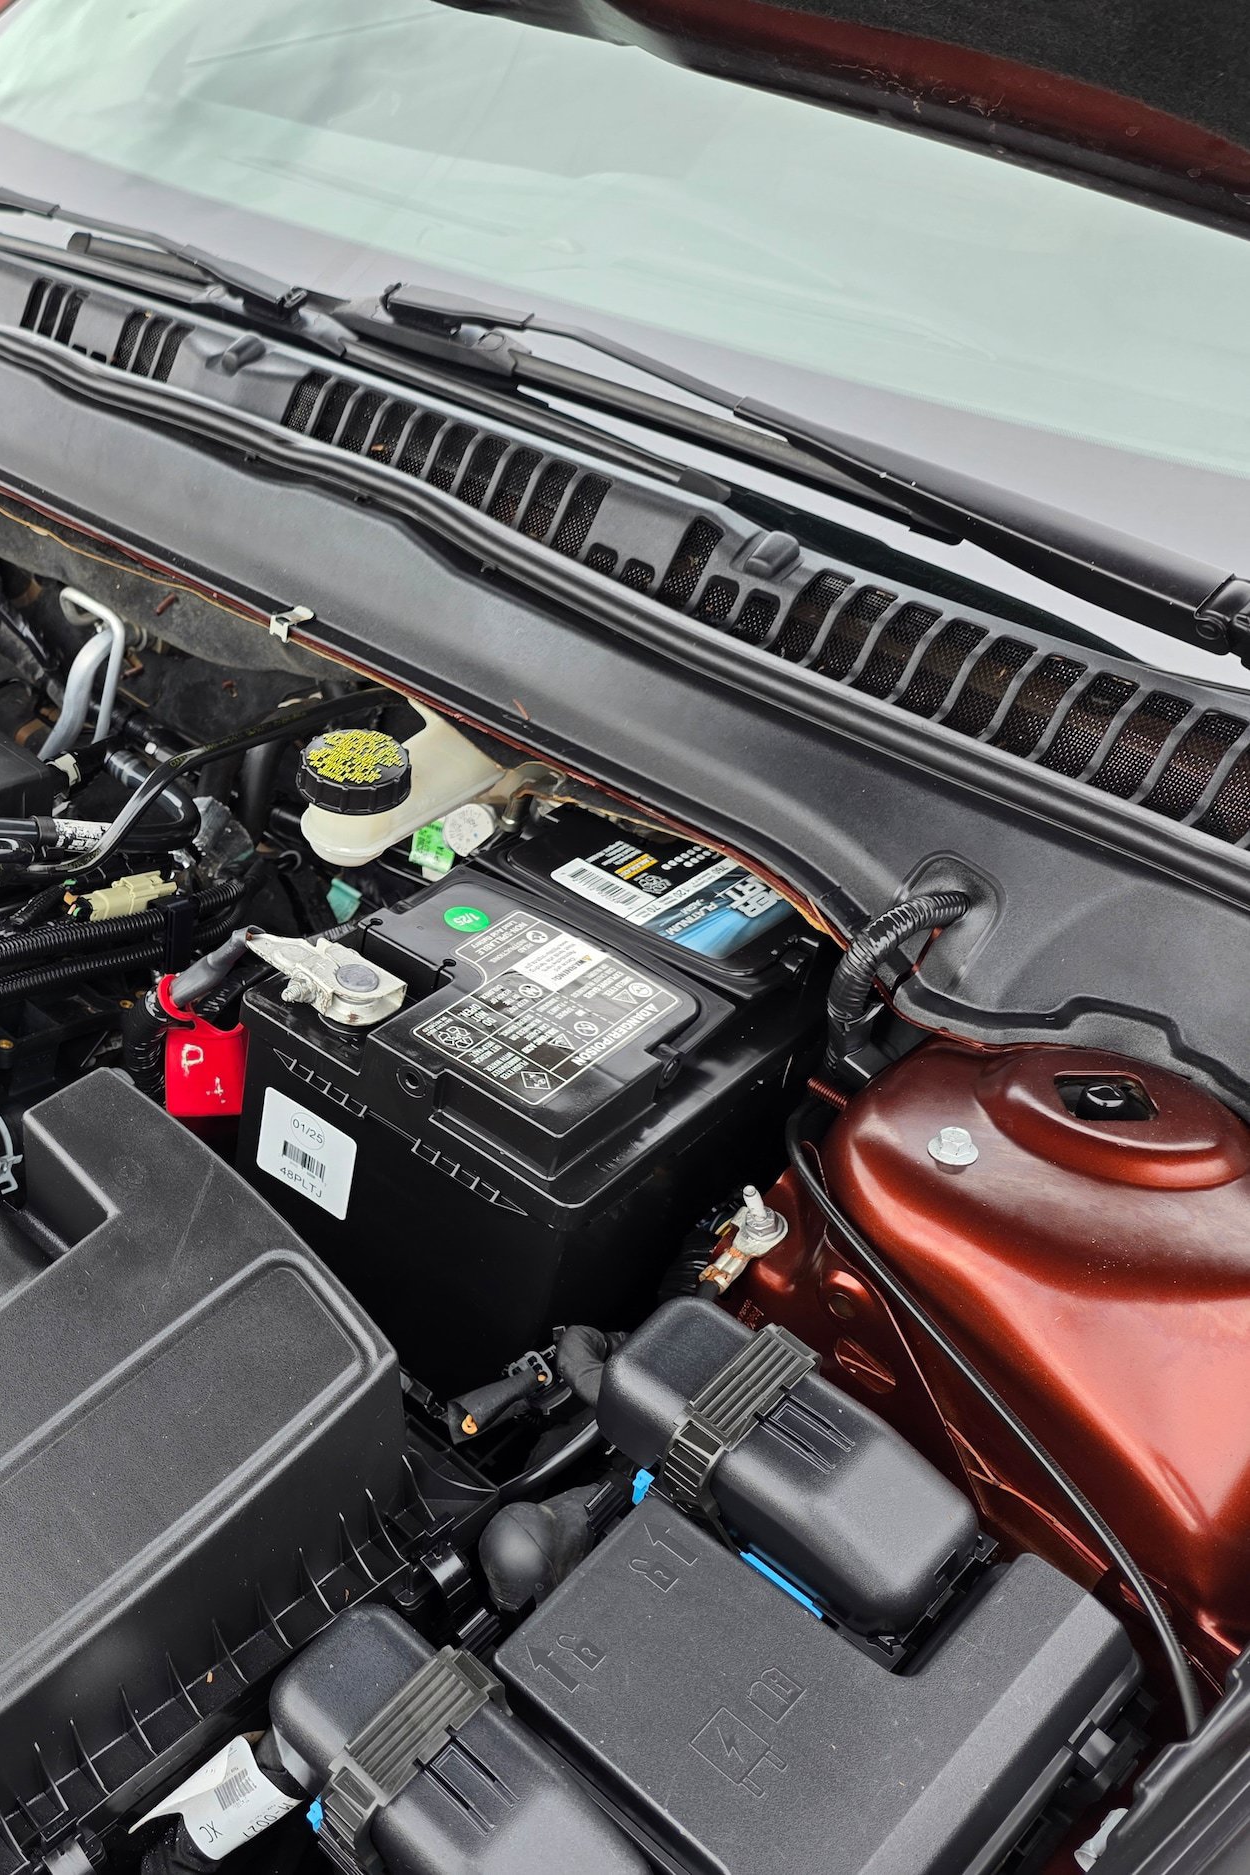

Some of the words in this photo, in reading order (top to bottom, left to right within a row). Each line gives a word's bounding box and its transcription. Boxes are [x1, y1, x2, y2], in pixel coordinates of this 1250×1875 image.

[453, 912, 481, 926] 1/25
[663, 901, 720, 935] PLATINUM
[474, 921, 527, 955] NON-SPILLABLE
[469, 1009, 488, 1022] NOT
[481, 1015, 497, 1026] DO
[569, 1006, 651, 1066] DANGER/POISON
[292, 1117, 323, 1144] 01/25
[279, 1164, 322, 1198] 48PLTJ
[199, 1820, 223, 1843] XC
